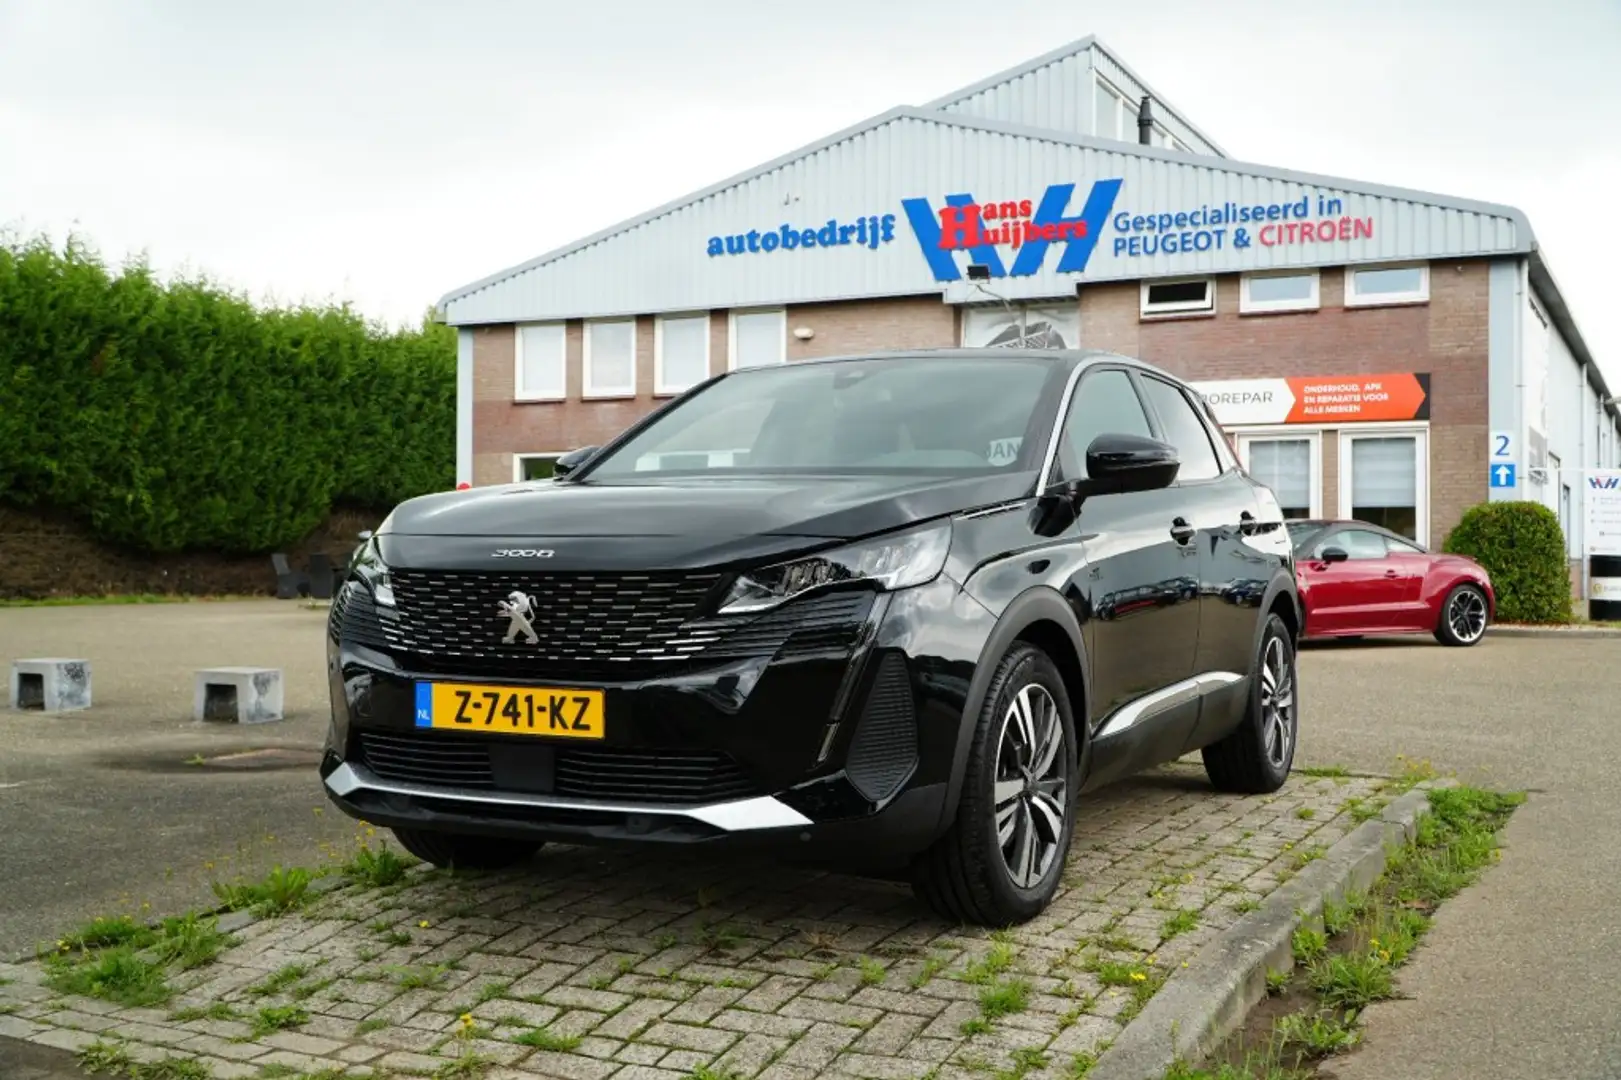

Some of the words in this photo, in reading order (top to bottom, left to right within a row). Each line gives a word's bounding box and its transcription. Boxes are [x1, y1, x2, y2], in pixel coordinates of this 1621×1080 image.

[1114, 196, 1309, 234] Gespecialiseerd
[1318, 195, 1342, 217] in
[707, 214, 896, 257] autobedrijf
[1114, 229, 1226, 257] PEUGEOT
[1232, 227, 1252, 249] &
[1259, 215, 1374, 248] CITROËN
[1494, 434, 1511, 457] 2
[491, 548, 556, 558] 3008
[417, 708, 431, 721] NL
[454, 690, 591, 731] Z-741-KZ
